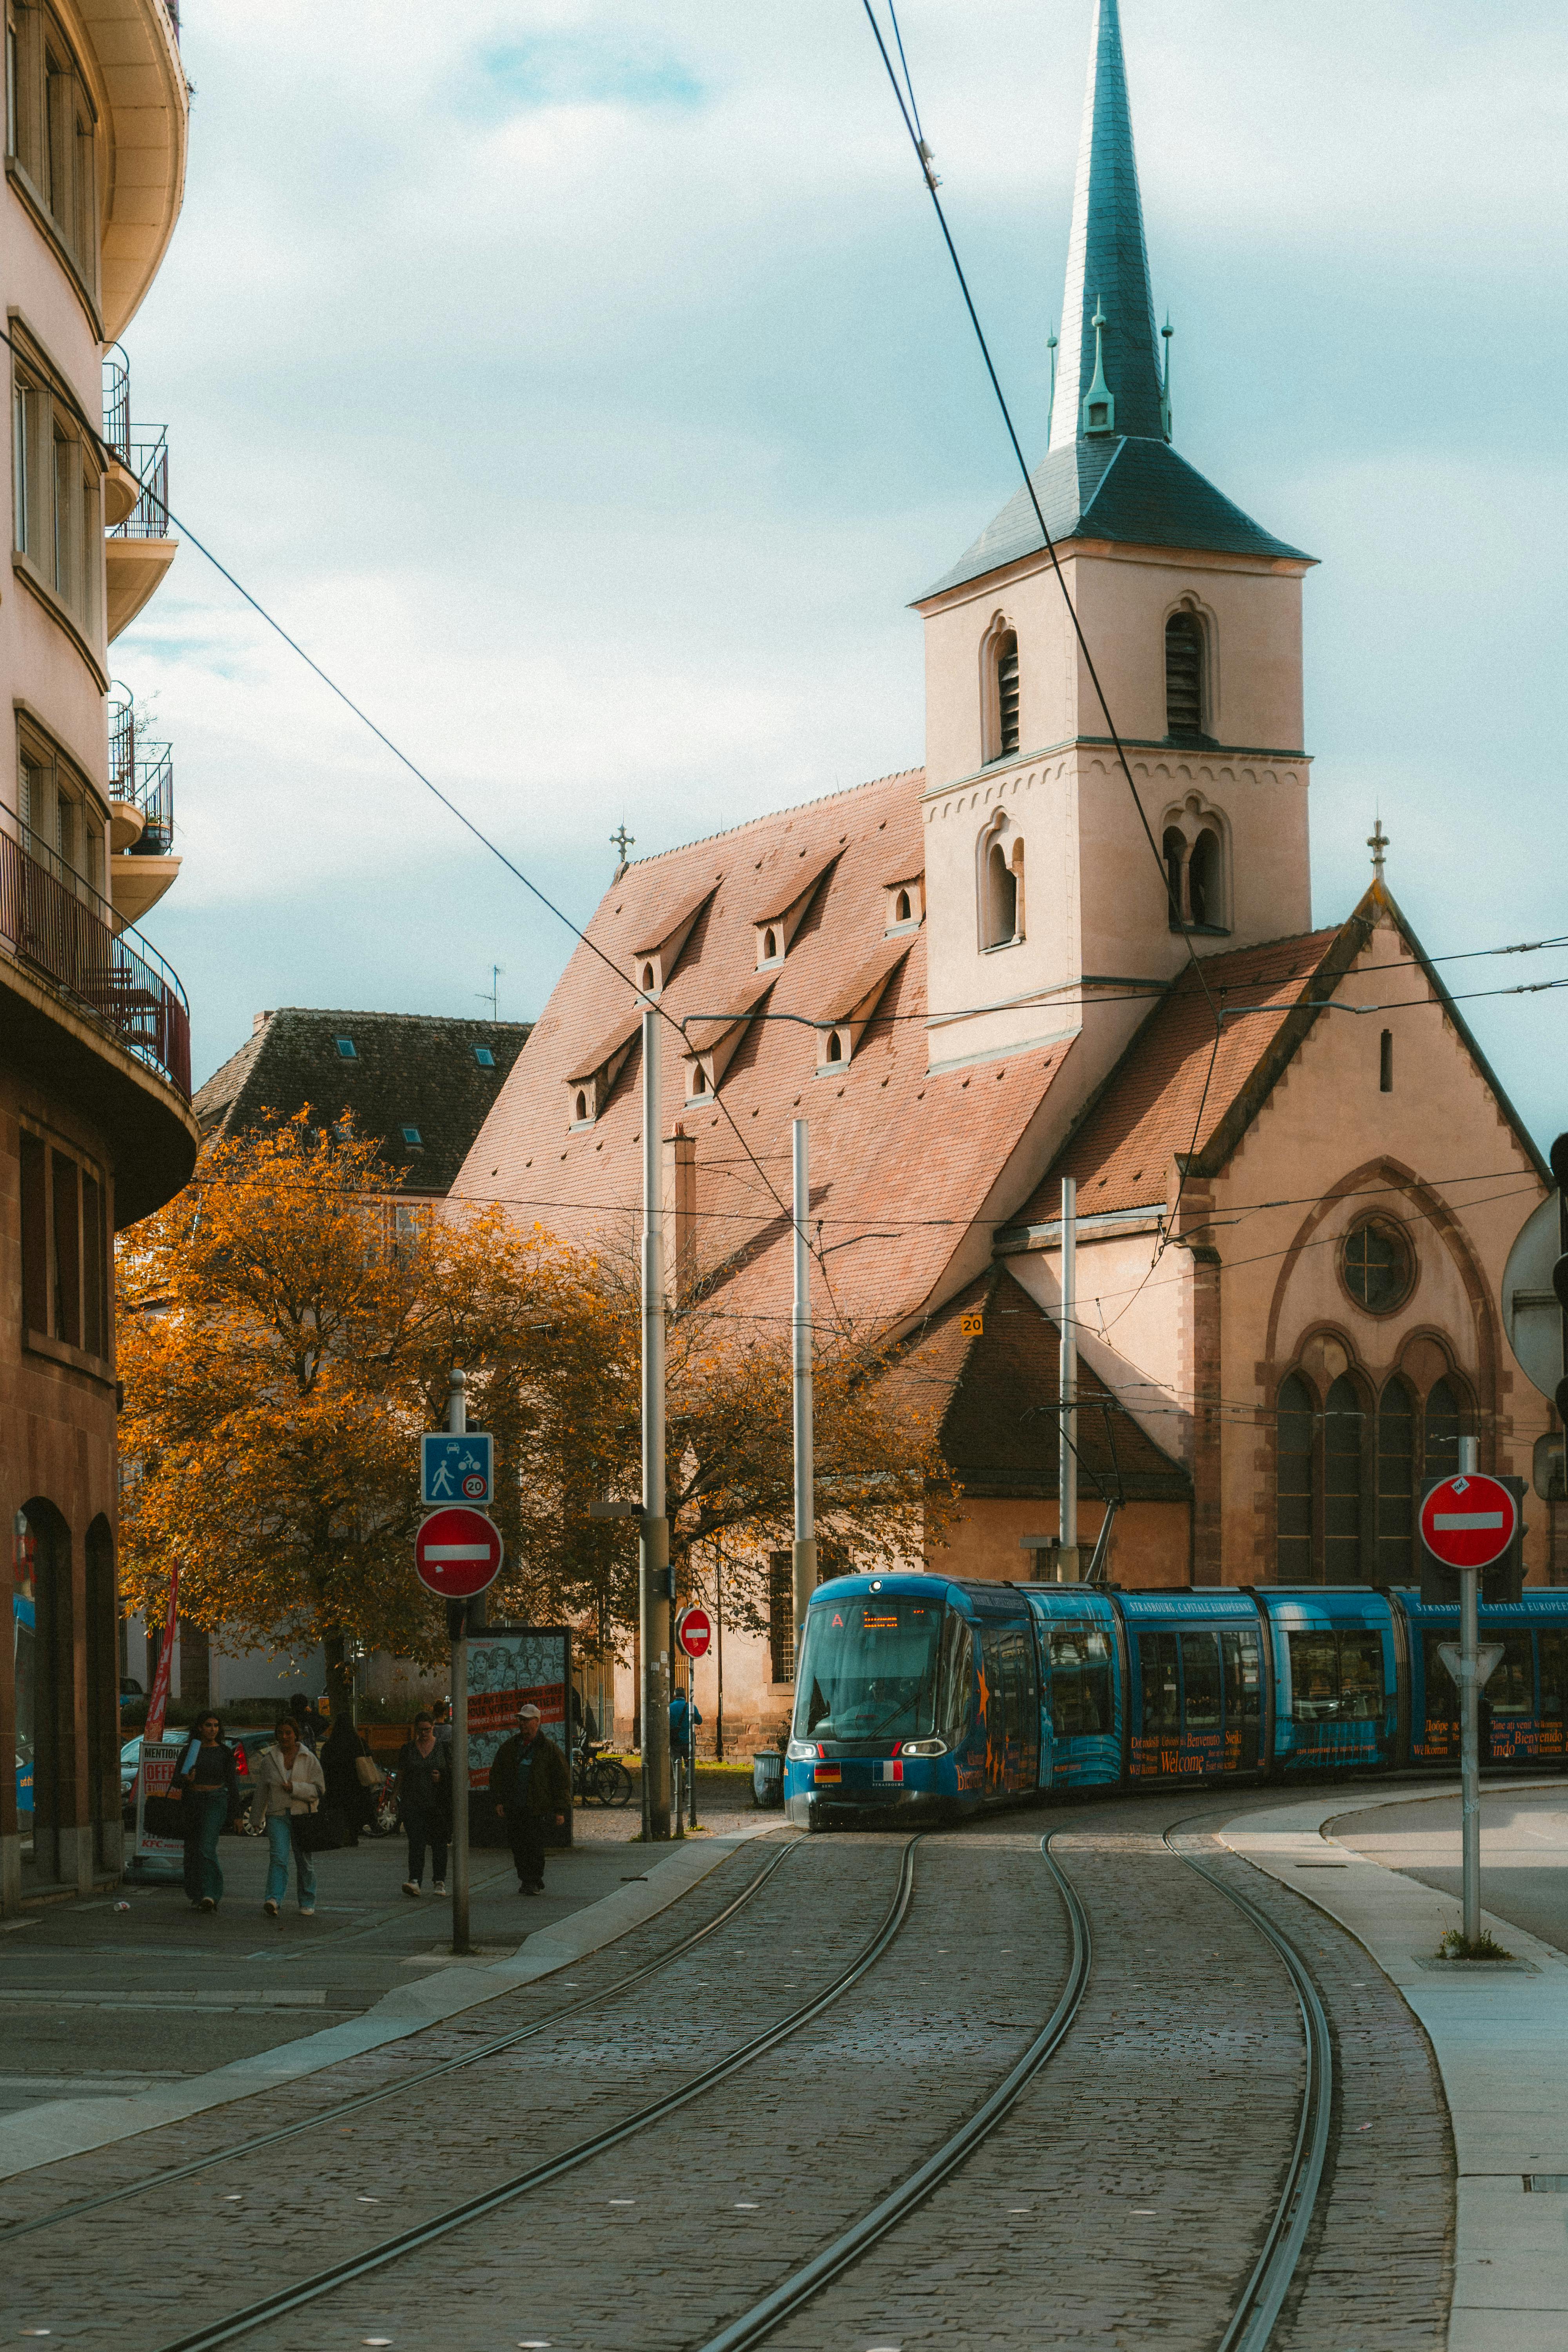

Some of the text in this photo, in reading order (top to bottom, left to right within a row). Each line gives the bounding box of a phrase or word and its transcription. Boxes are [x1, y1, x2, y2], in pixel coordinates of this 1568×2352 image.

[964, 1319, 981, 1331] 20
[468, 1482, 482, 1491] 20
[1129, 1601, 1253, 1613] STRASBOURG, CAPITALE EUROPÉENNE
[832, 1614, 843, 1627] A
[468, 1706, 486, 1717] OUR
[488, 1702, 514, 1714] VOTRE
[468, 1715, 501, 1726] ROPOSEZ-LES
[1187, 1732, 1220, 1748] Benvenuto
[1225, 1730, 1242, 1744] Sveiki
[1515, 1729, 1563, 1744] Bienvenido
[1161, 1749, 1205, 1773] Welcome
[142, 1839, 163, 1848] KFC
